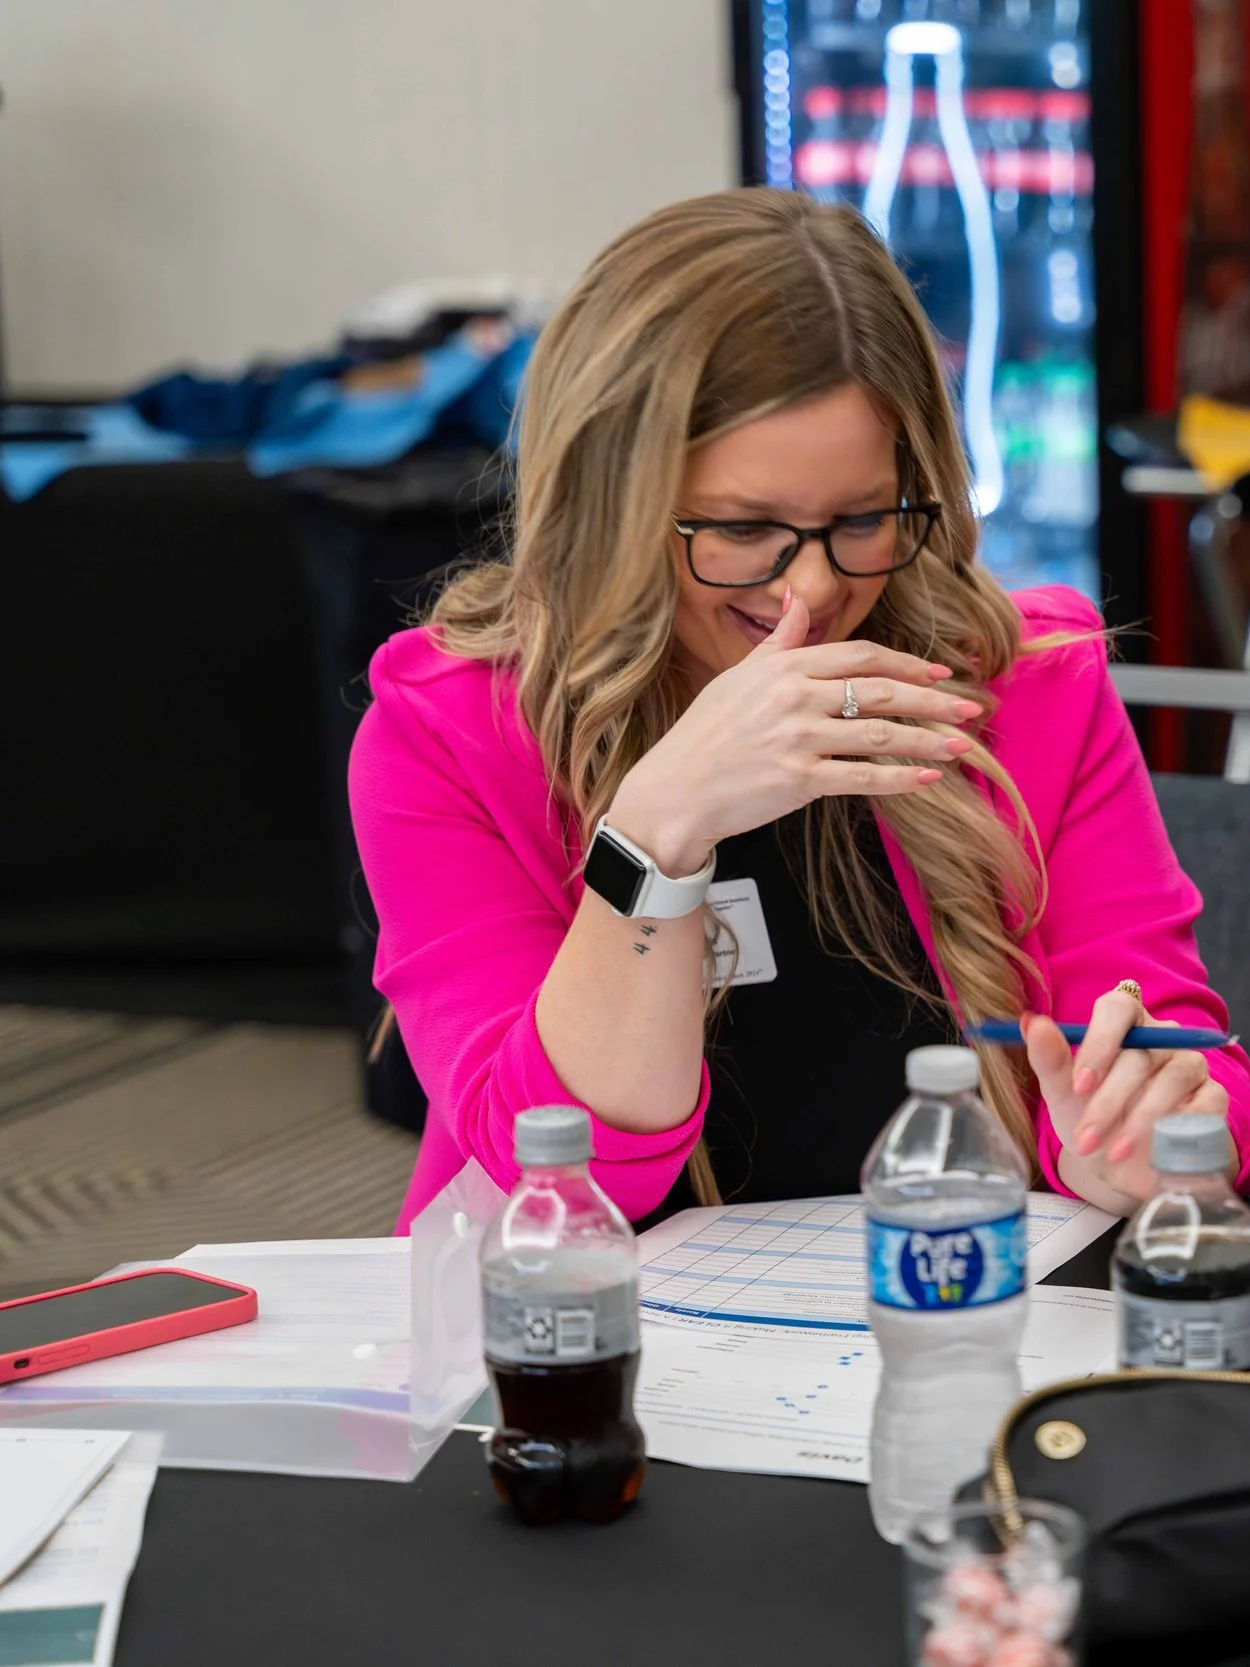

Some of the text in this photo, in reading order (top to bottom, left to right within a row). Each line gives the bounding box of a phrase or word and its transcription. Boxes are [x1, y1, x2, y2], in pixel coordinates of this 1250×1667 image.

[909, 1231, 973, 1258] Pure
[915, 1257, 968, 1288] Life
[678, 1318, 721, 1328] CLEAR
